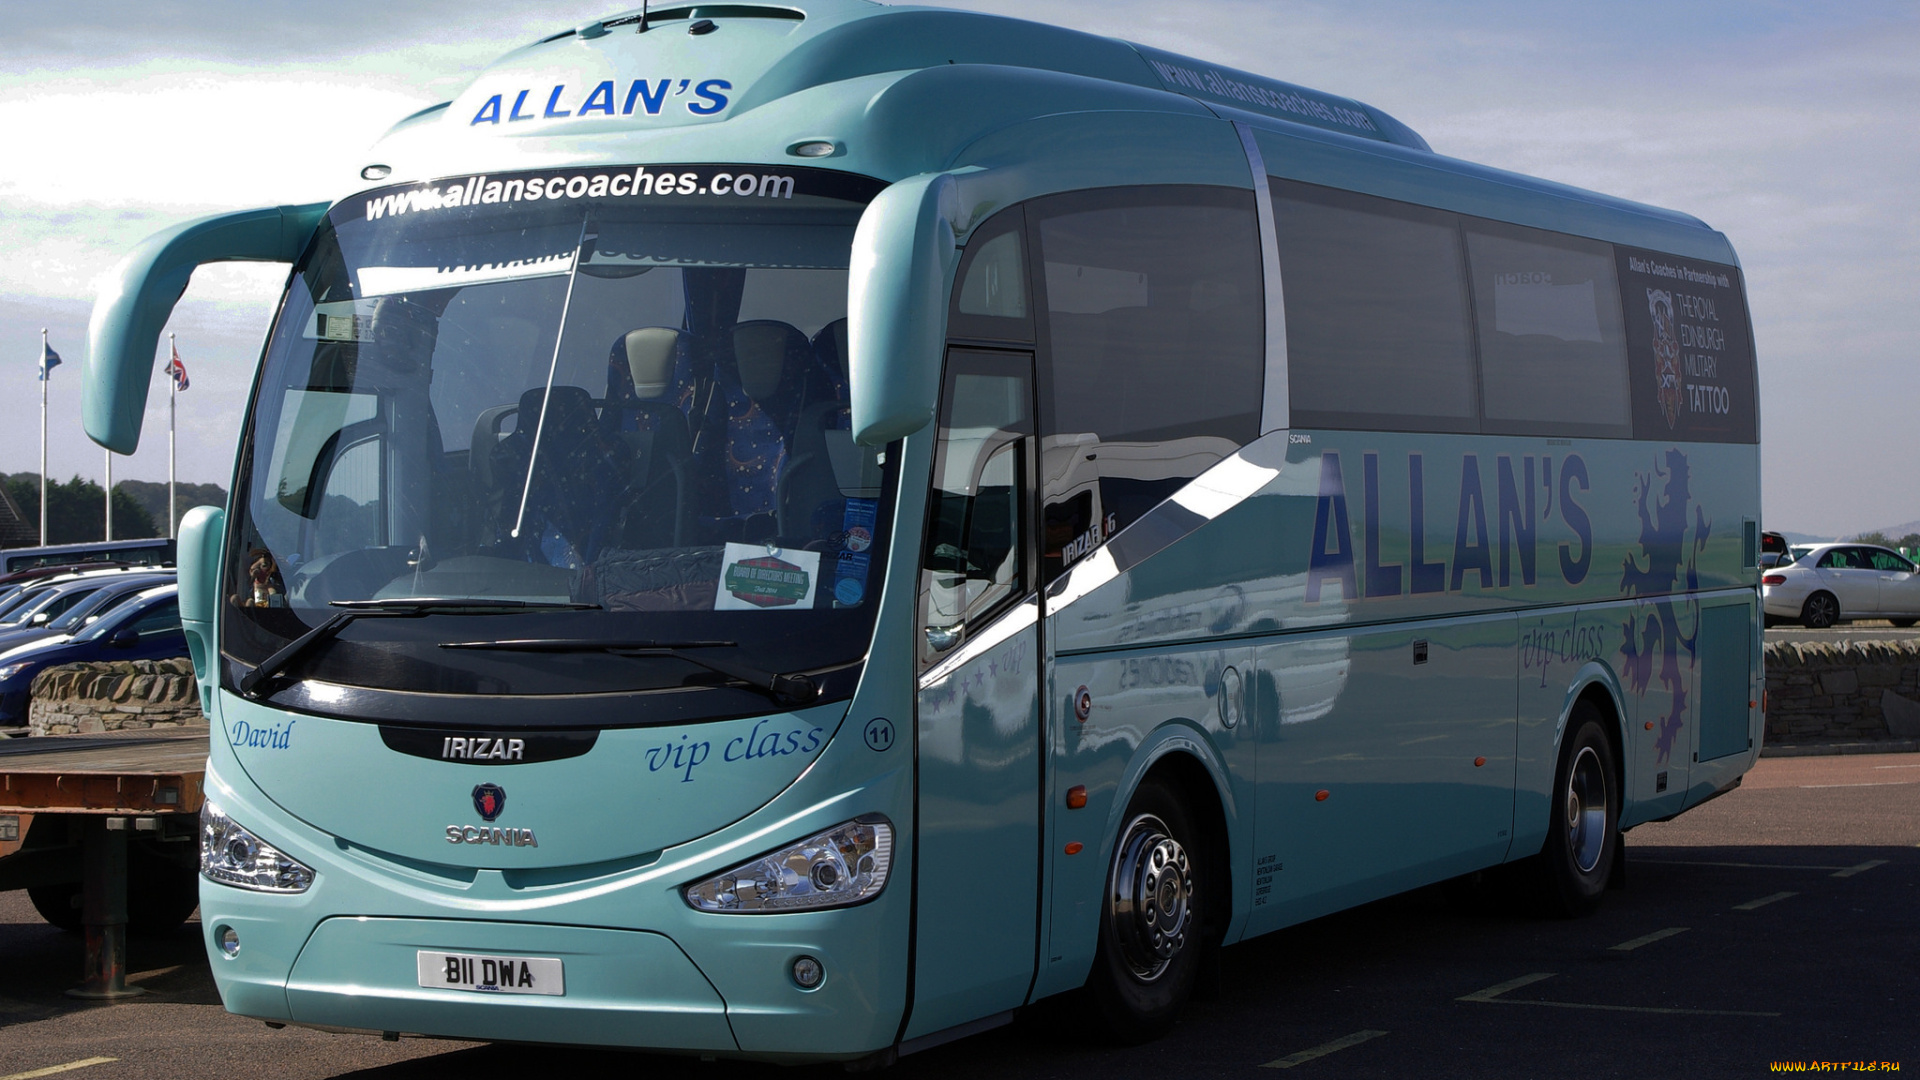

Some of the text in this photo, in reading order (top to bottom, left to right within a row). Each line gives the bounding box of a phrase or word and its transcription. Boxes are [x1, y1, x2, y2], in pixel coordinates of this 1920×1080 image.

[469, 77, 735, 127] ALLAN'S
[1150, 59, 1377, 131] www.allanscoaches.com
[1629, 256, 1730, 289] Allan's Coaches in Partnership with
[1676, 293, 1719, 322] THE ROYAL
[1680, 323, 1726, 352] EDINBURGH
[1684, 353, 1718, 379] MILITARY
[1686, 384, 1730, 415] TATTOO
[1289, 434, 1312, 444] SCANIA
[1304, 448, 1594, 606] ALLAN'S
[1062, 524, 1100, 567] IRIZAR
[733, 565, 750, 578] BOARD
[757, 568, 784, 582] DIRECTORS
[783, 571, 805, 585] MEETING
[1002, 638, 1027, 675] vip
[1523, 607, 1604, 688] vip class
[232, 720, 296, 750] David
[442, 737, 526, 760] IRIZAR
[869, 727, 889, 744] 11
[645, 720, 823, 783] vip class
[445, 825, 538, 848] SCANIA
[482, 959, 533, 988] DWA
